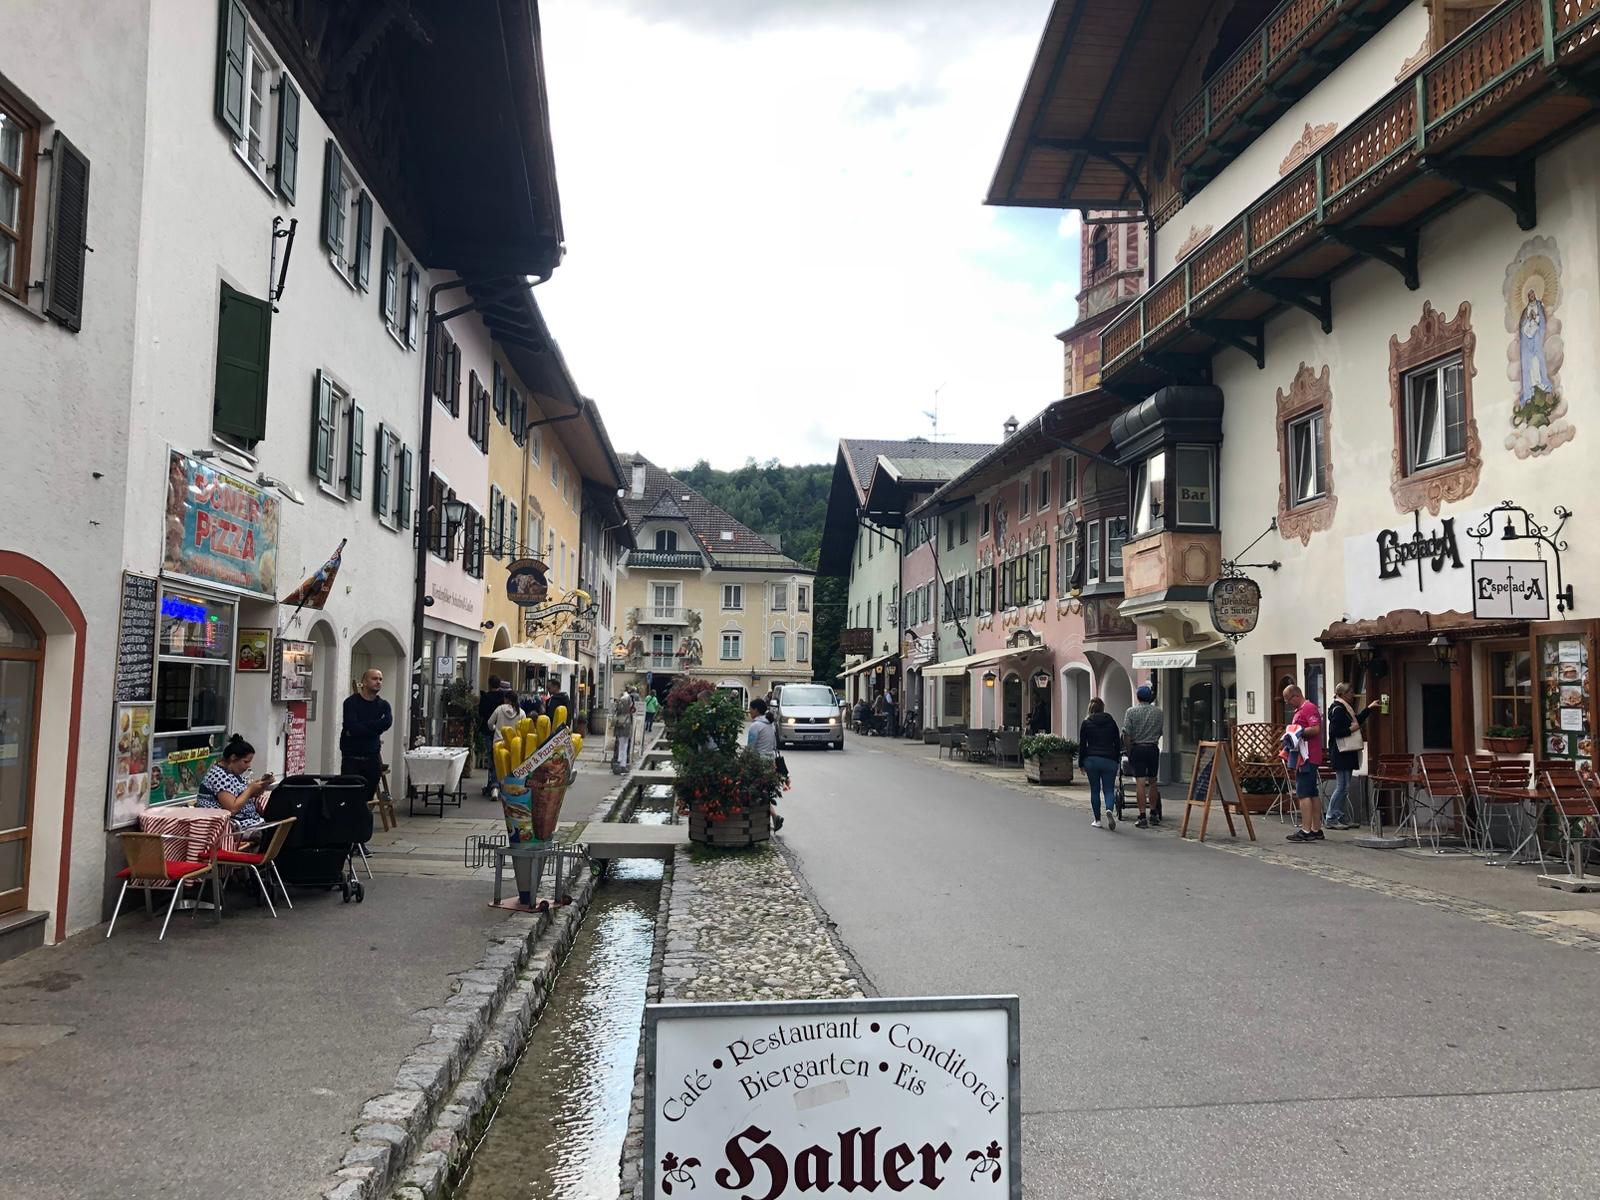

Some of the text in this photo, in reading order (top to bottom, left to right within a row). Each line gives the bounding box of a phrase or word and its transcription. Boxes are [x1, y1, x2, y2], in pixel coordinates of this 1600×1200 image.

[1181, 488, 1207, 501] Bar
[538, 745, 556, 760] Pizza
[662, 1017, 1005, 1122] Café Restaurant Conditorei
[738, 1053, 927, 1102] Biergarten Eis
[714, 1125, 953, 1200] Haller
